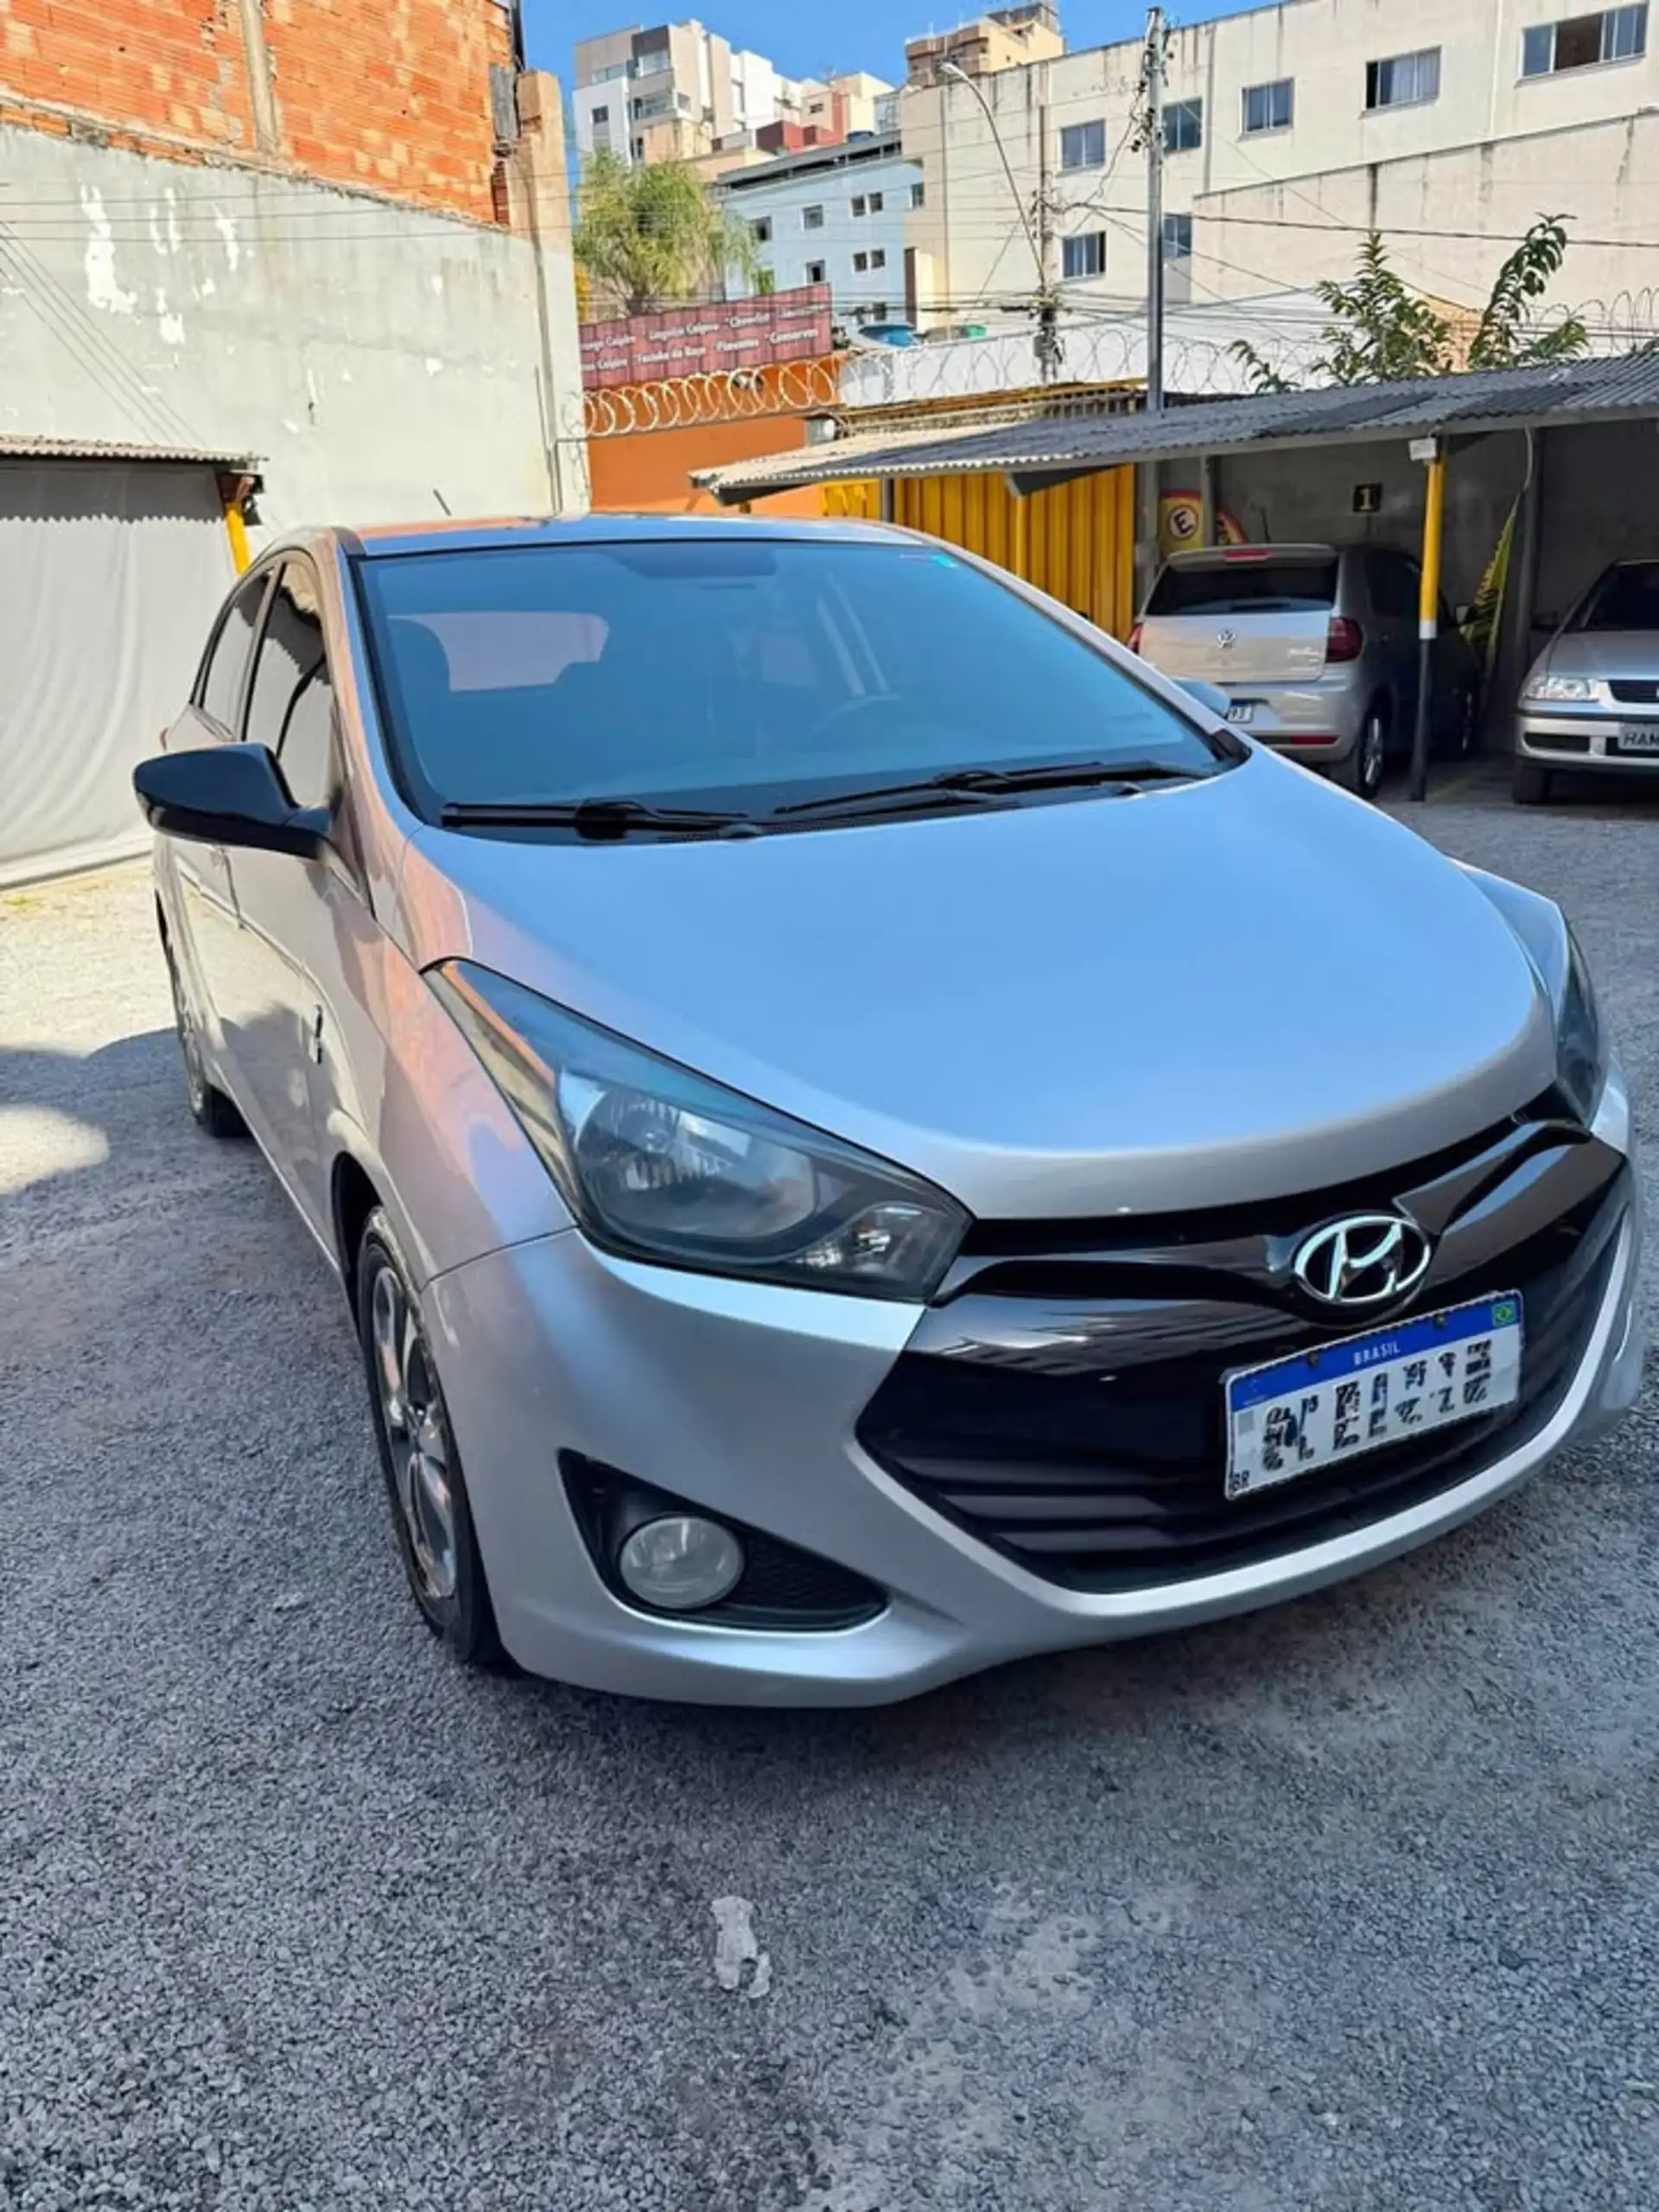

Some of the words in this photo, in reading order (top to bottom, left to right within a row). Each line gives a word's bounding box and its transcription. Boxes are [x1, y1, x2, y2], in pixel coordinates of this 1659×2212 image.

[1359, 487, 1373, 510] 1
[1173, 511, 1194, 534] E
[1353, 1340, 1401, 1365] BRASIL
